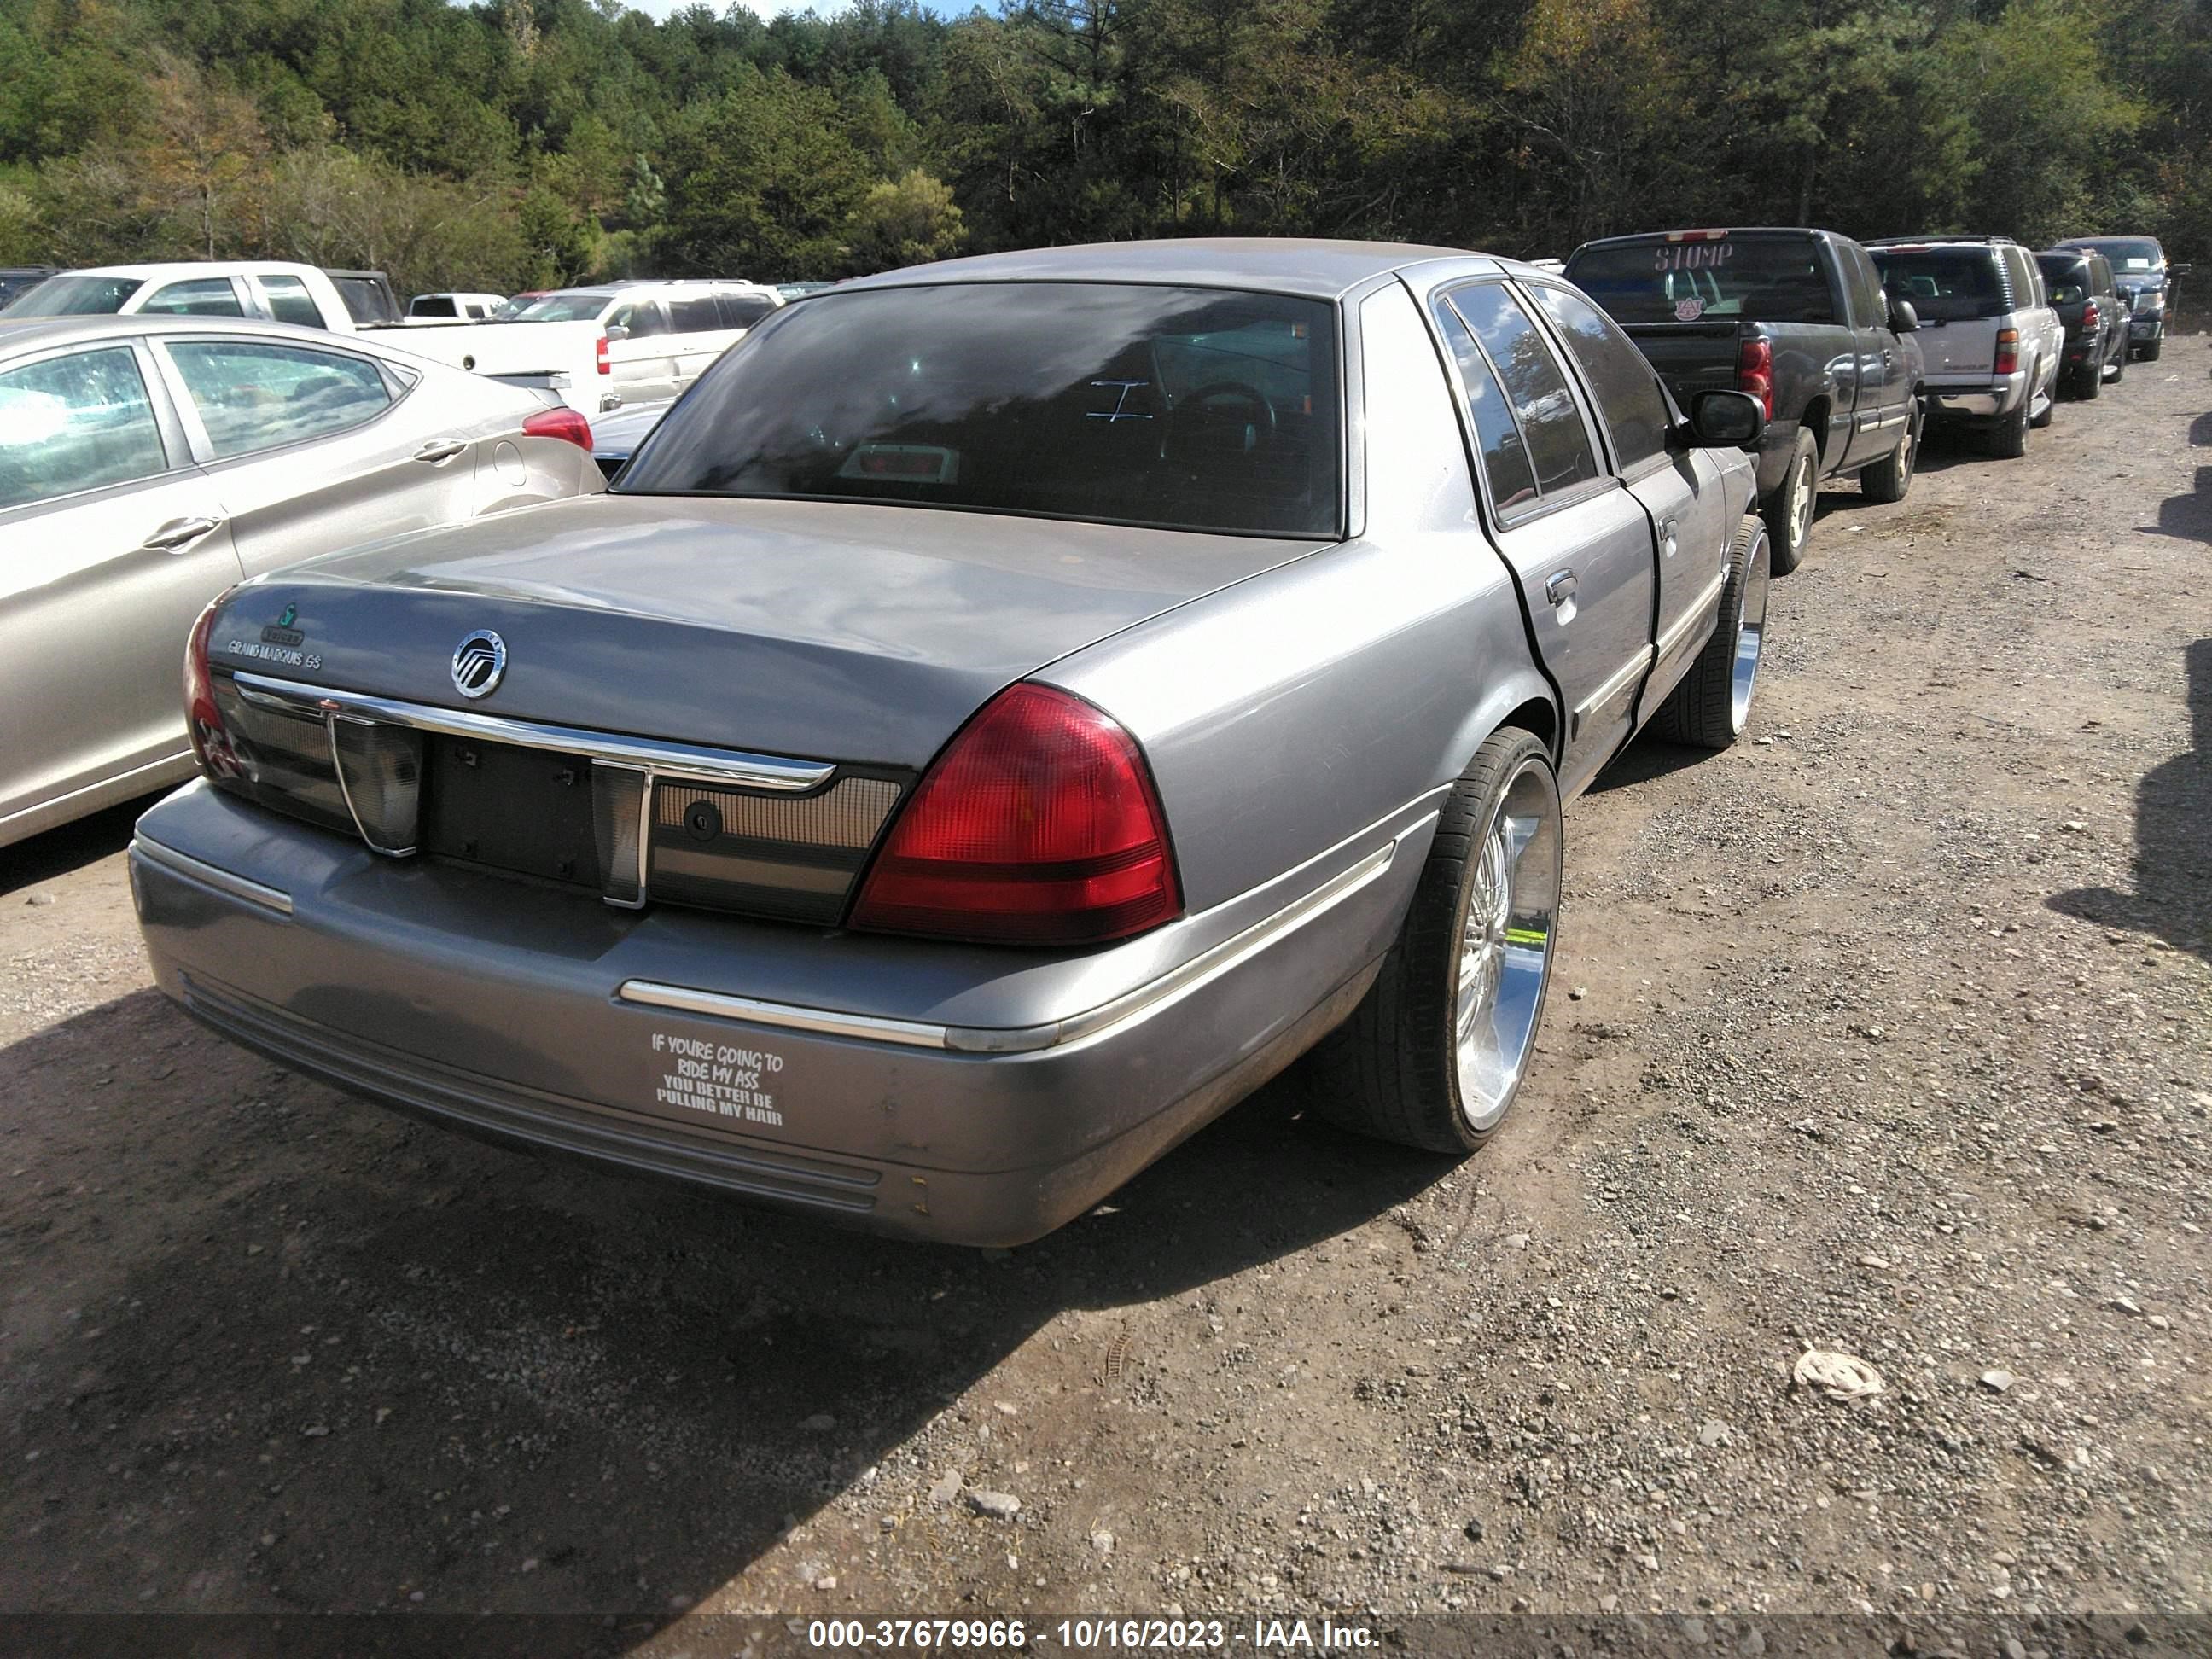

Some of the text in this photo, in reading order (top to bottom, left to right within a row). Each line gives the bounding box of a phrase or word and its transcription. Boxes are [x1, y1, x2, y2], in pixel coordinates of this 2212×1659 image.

[227, 640, 322, 670] GRAND MARQUIS GS
[651, 1033, 783, 1073] IF YOURE GOING TO
[663, 1074, 773, 1109] YOU BETTER BE
[678, 1058, 760, 1090] RIDE MY ASS
[656, 1088, 783, 1126] PULLING MY HAIR
